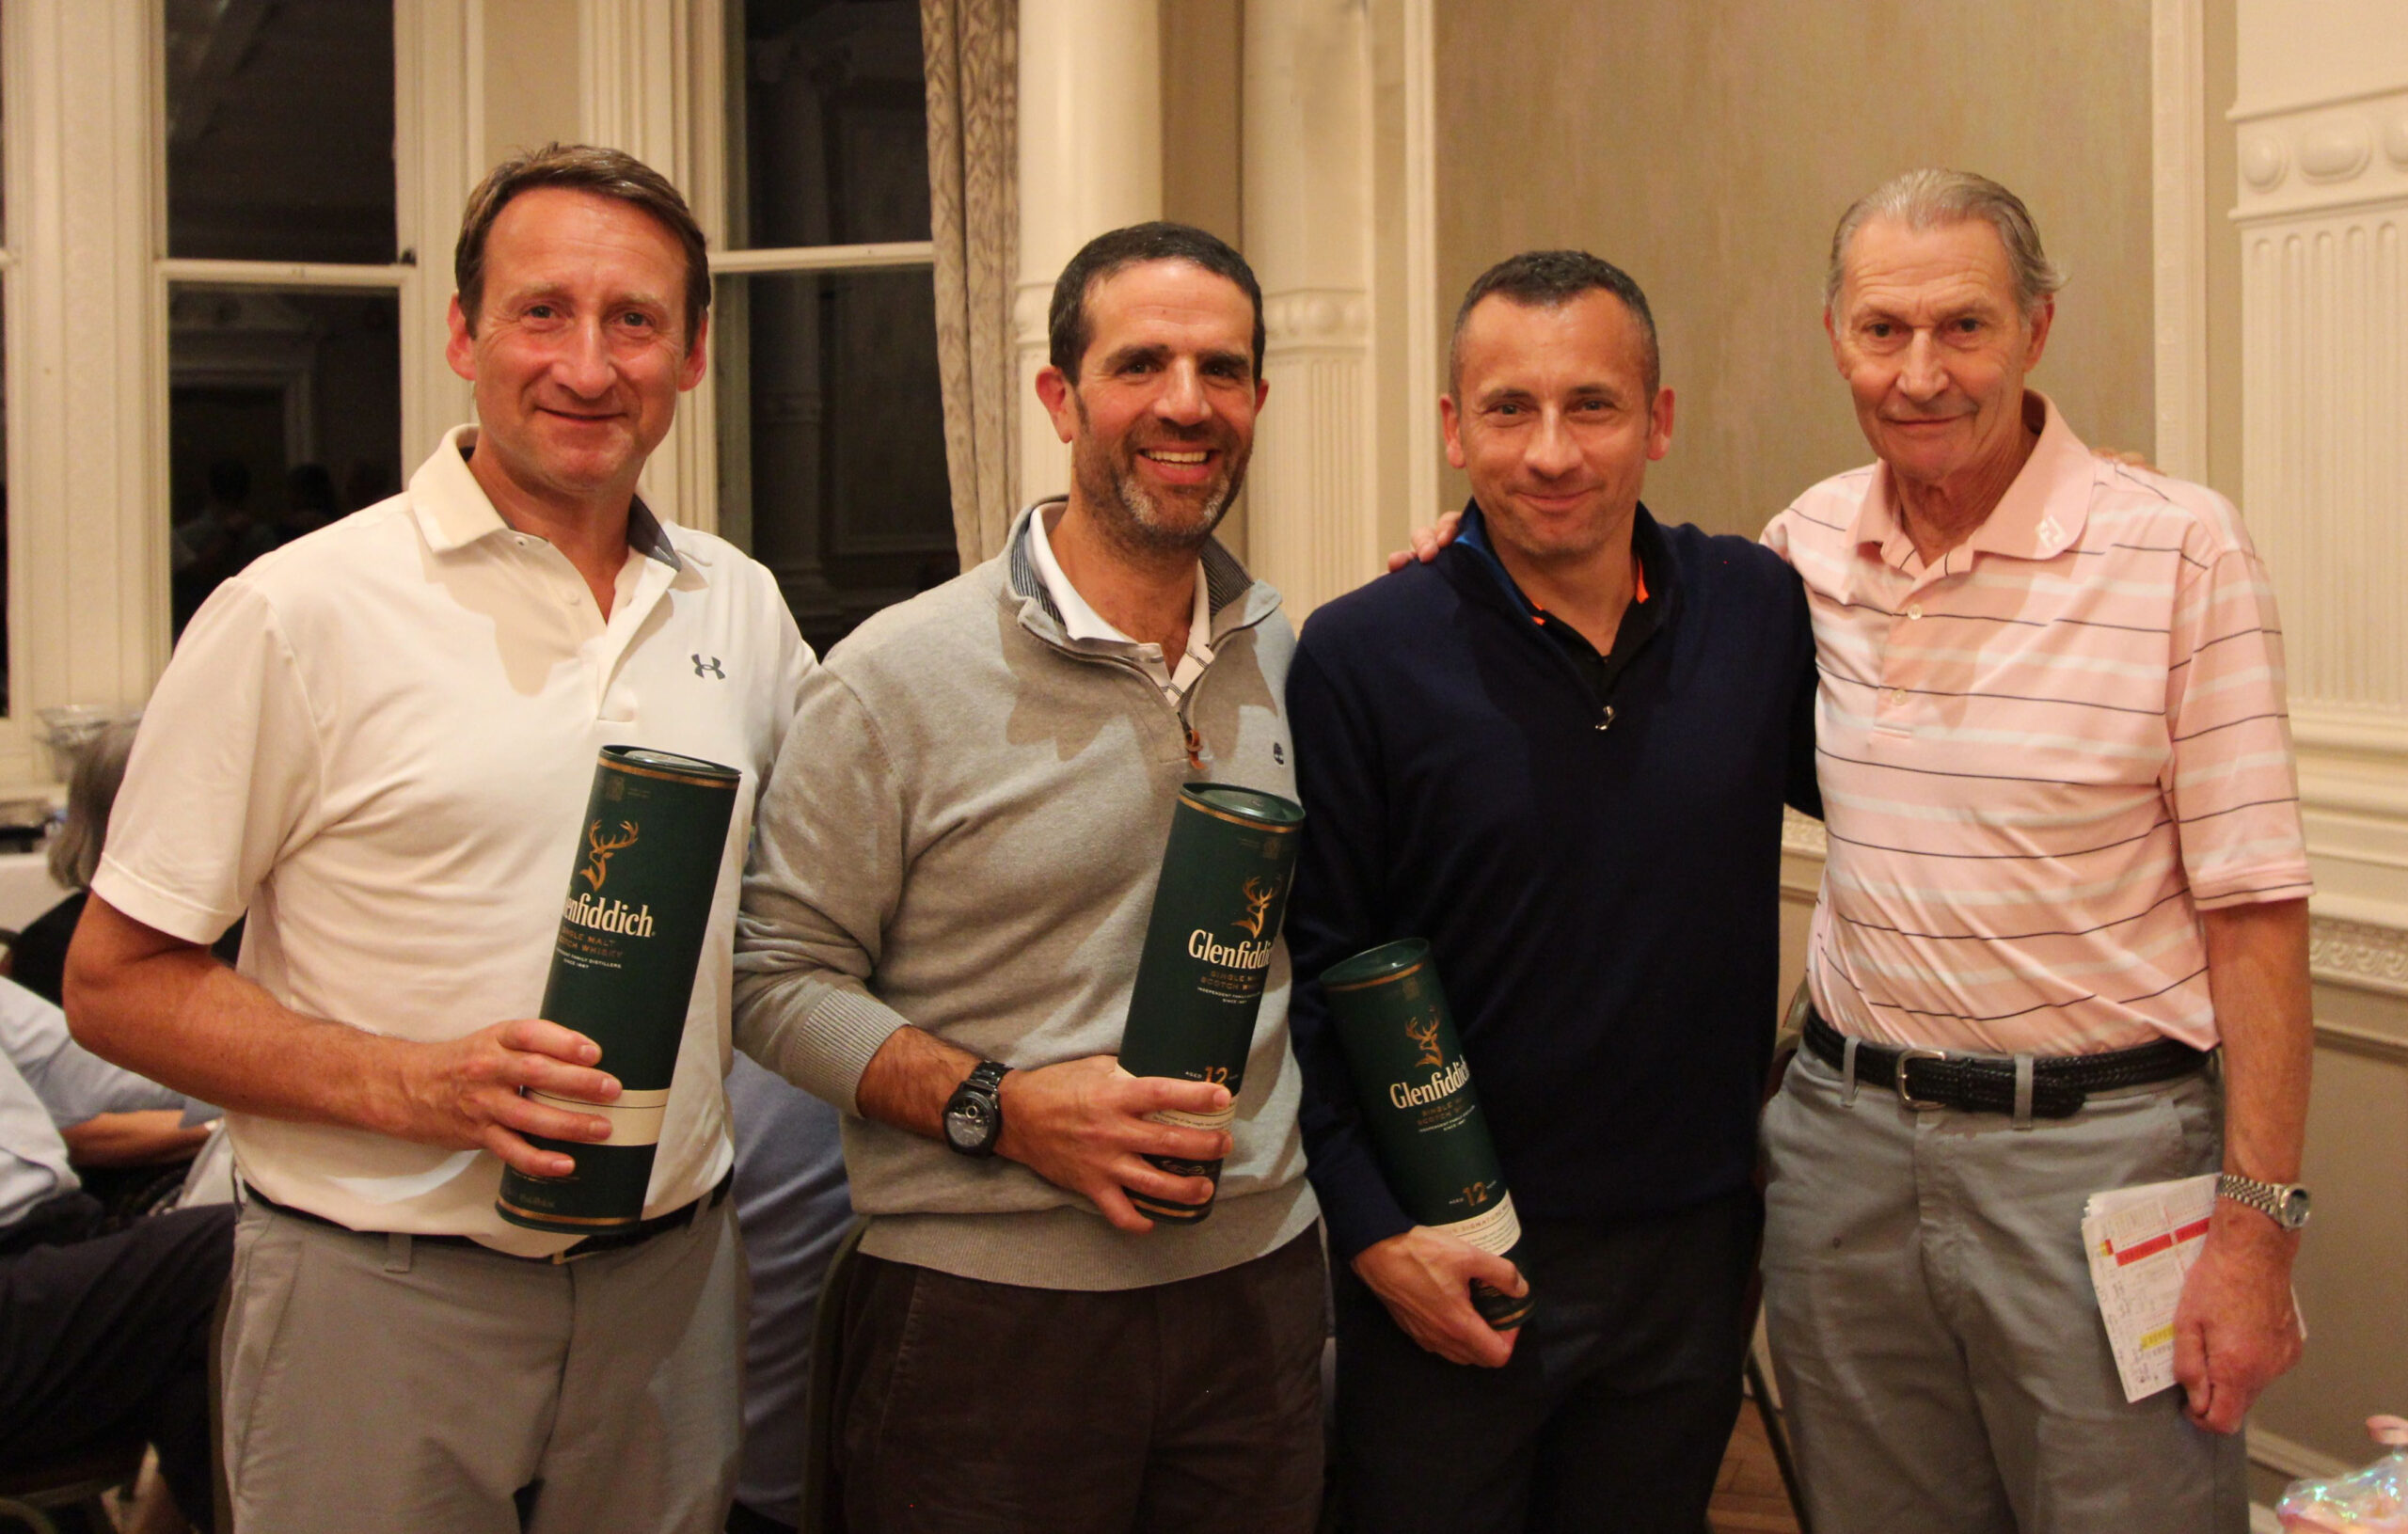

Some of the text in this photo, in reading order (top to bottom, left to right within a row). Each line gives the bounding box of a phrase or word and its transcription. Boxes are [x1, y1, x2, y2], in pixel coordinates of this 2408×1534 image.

[564, 893, 654, 938] enfiddich
[1188, 928, 1272, 970] Glenfiddi
[1204, 1066, 1229, 1084] 12
[1463, 1181, 1488, 1207] 12
